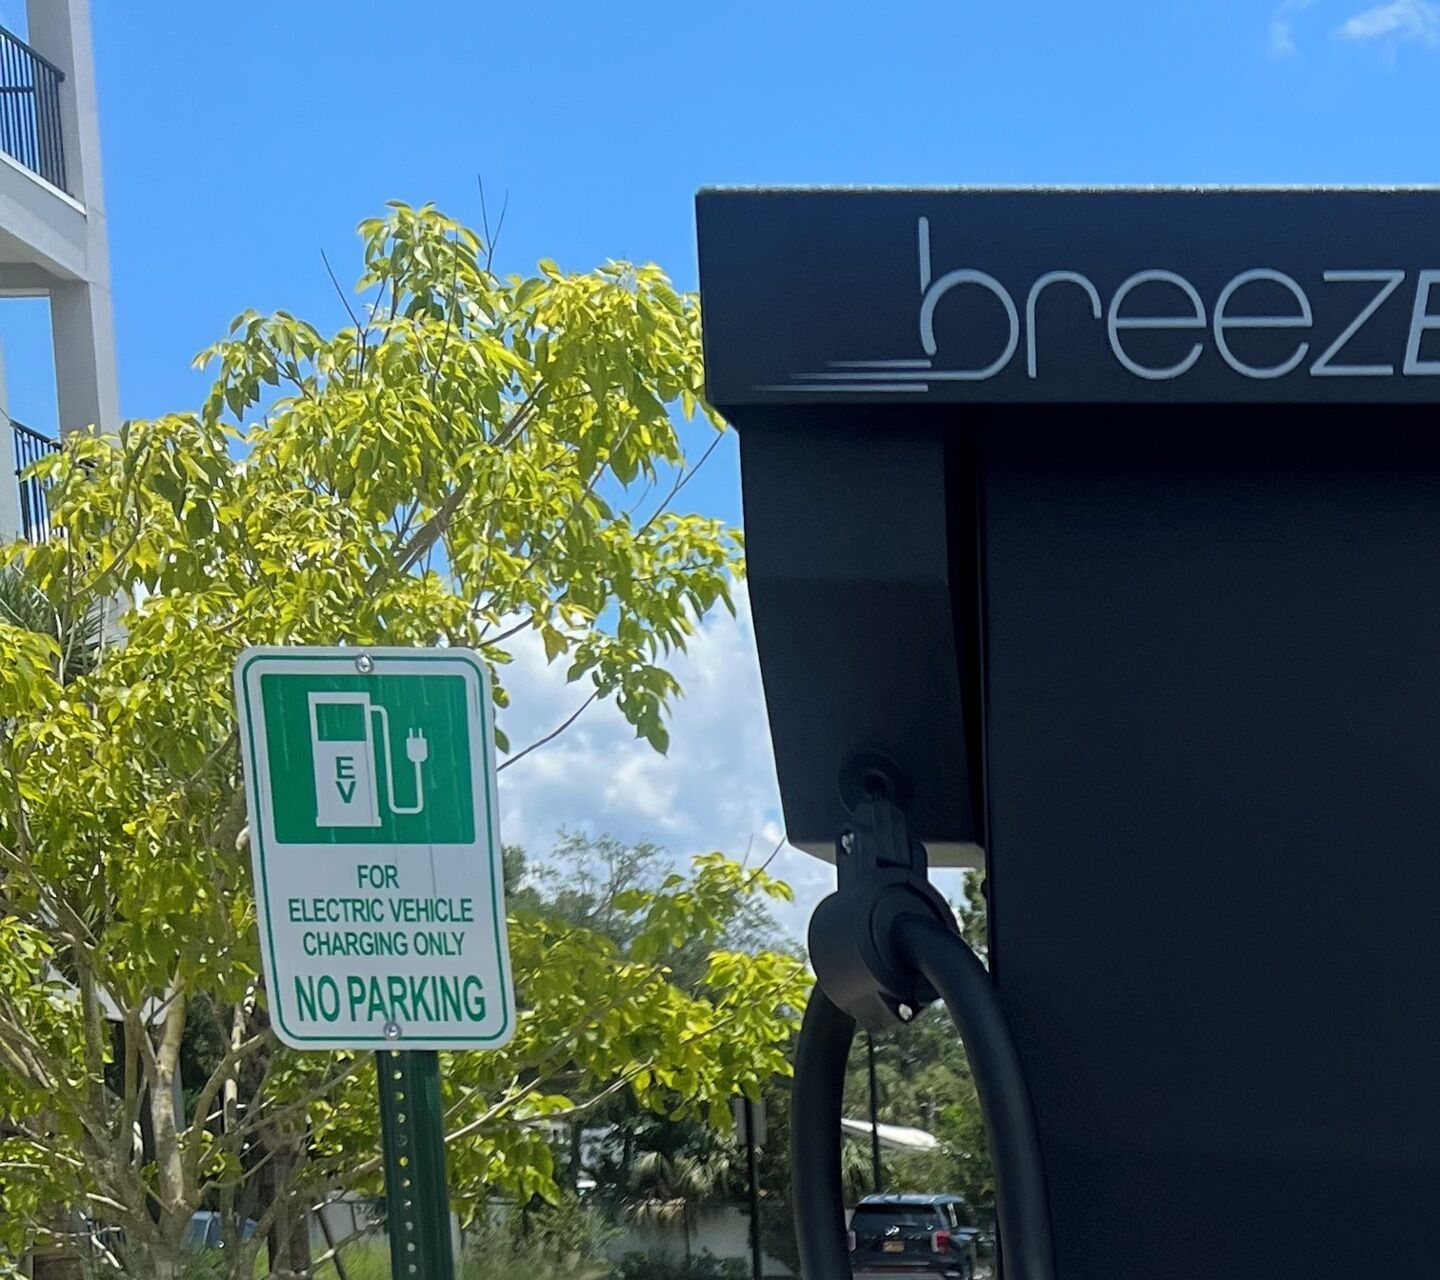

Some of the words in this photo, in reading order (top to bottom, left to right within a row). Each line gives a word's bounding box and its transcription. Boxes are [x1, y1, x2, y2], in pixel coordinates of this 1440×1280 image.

[356, 864, 400, 889] FOR
[288, 898, 385, 923] ELECTRIC
[389, 898, 474, 923] VEHICLE
[302, 931, 408, 957] CHARGING
[413, 931, 465, 957] ONLY
[293, 974, 340, 1023] NO
[348, 975, 486, 1023] PARKING
